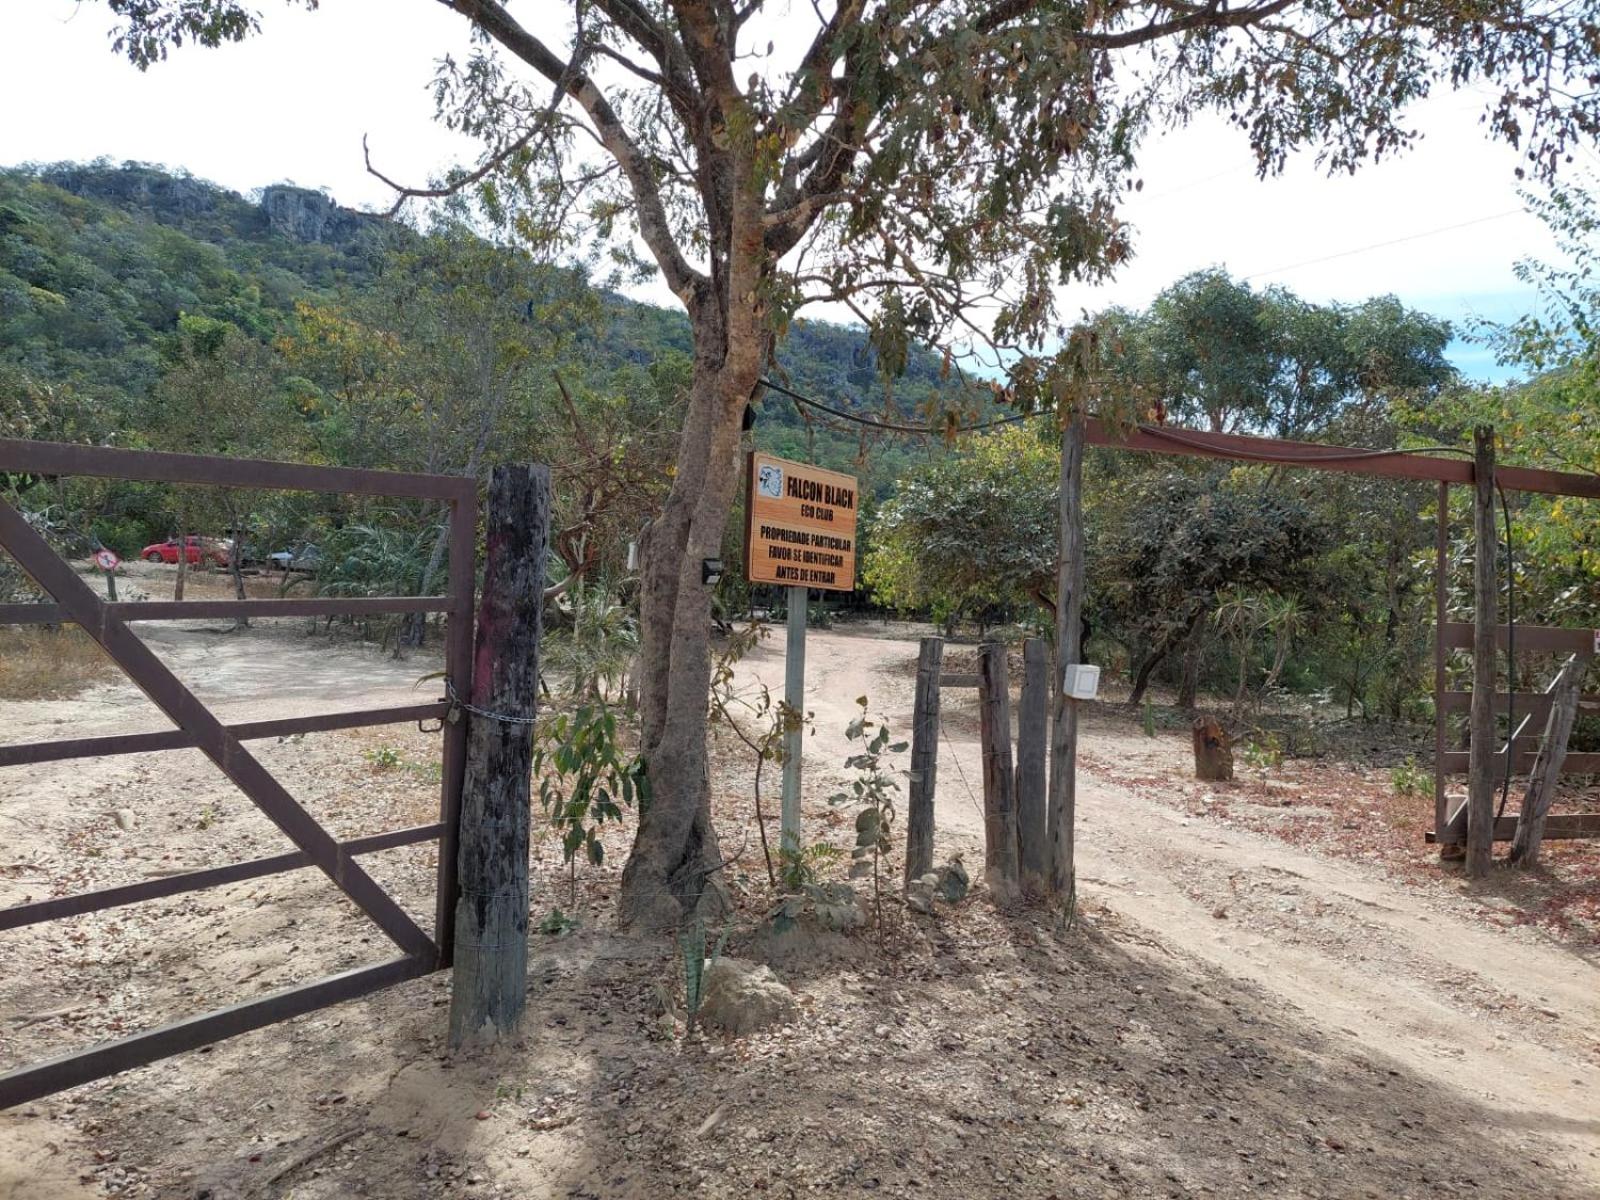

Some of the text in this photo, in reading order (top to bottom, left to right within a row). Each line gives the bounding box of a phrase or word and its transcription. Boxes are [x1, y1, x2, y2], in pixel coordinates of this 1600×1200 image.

[788, 476, 853, 509] FALCON BLACK
[801, 504, 834, 521] ECO CLUB
[761, 526, 851, 552] PROPRIEDADE PARTICULAR
[769, 546, 843, 567] FAVOR SE IDENTIFICAR
[776, 566, 835, 584] ANTES DE ENTRAR
